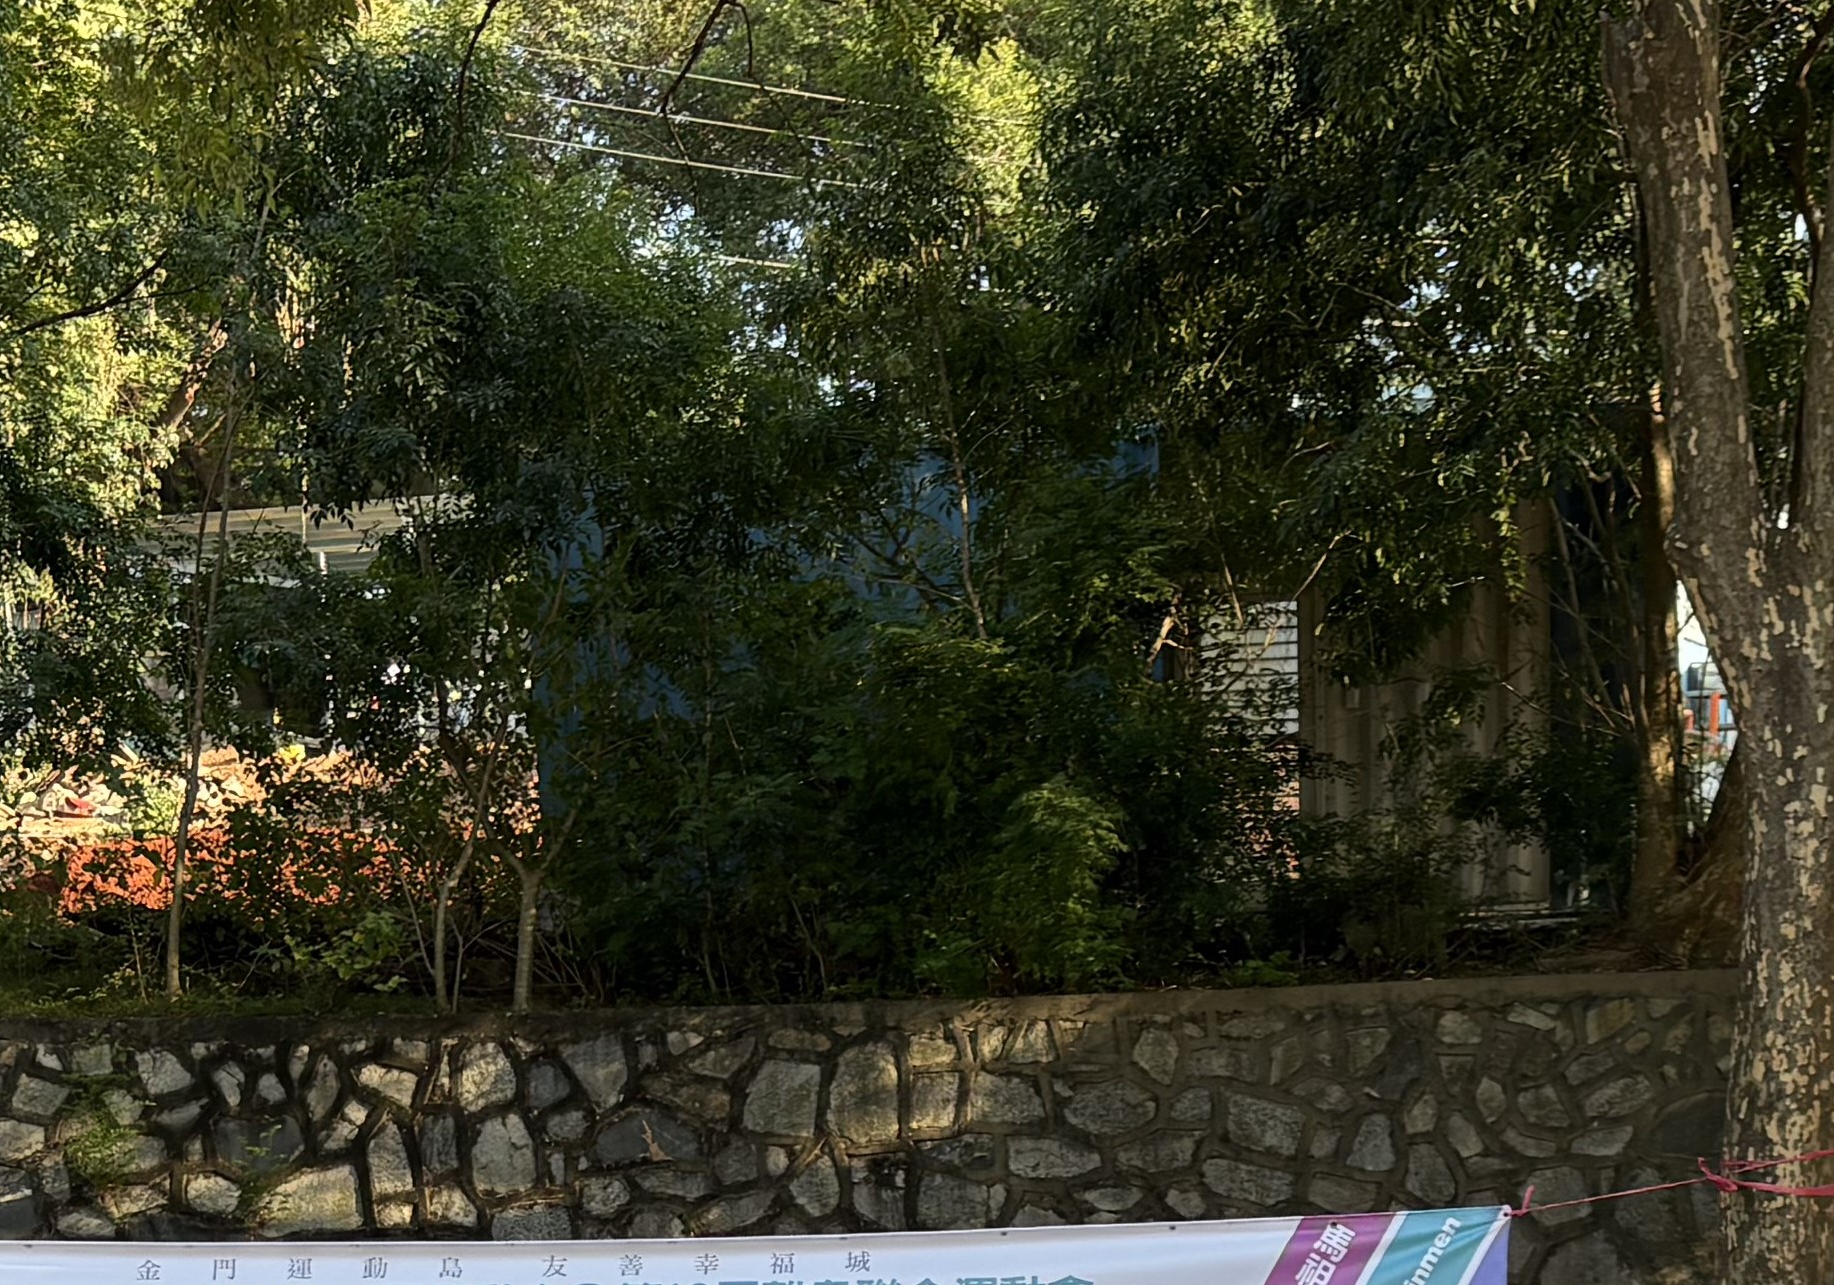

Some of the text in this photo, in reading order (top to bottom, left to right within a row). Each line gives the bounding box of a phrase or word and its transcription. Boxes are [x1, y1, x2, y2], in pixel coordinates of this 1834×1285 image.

[136, 1250, 871, 1281] 金門運動島 友善幸福城
